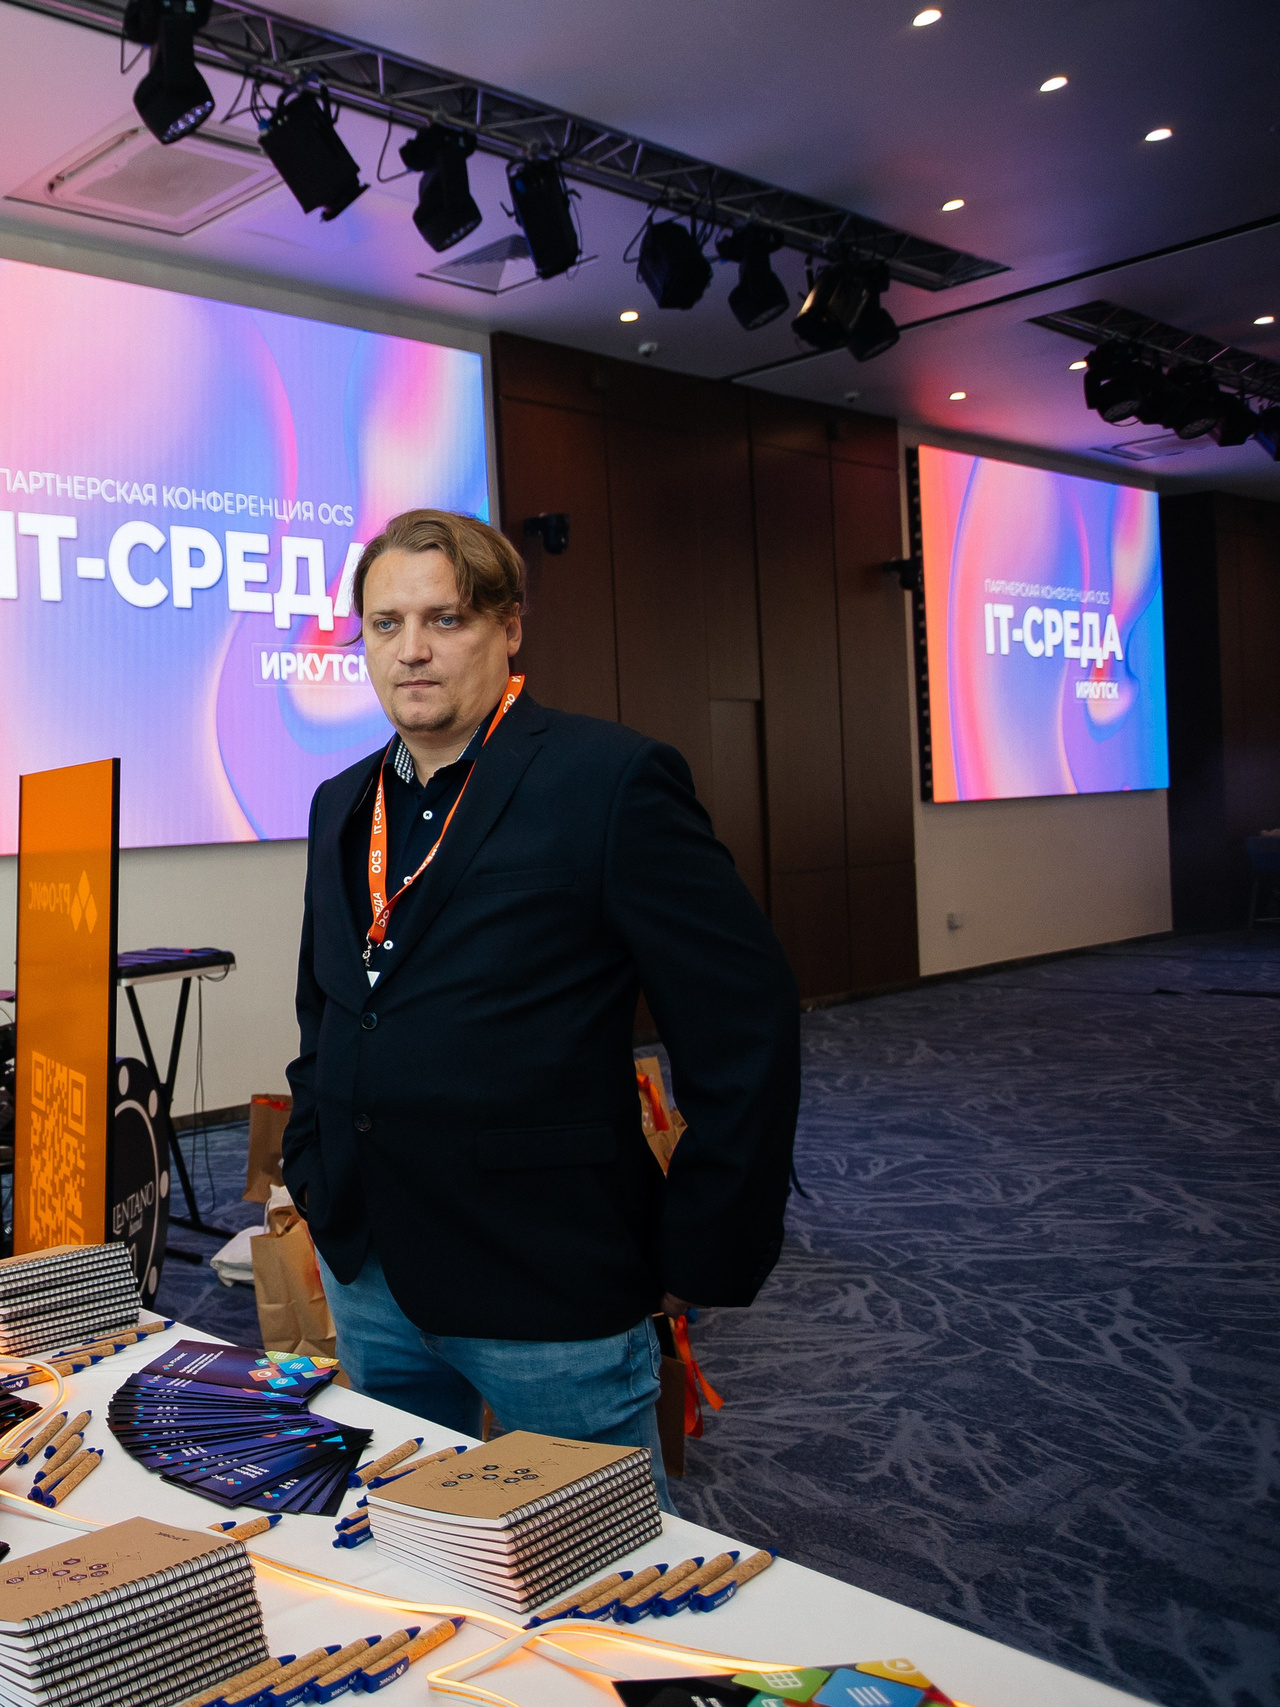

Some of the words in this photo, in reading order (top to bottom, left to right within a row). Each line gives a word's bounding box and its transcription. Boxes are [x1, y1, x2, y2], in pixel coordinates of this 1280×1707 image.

[162, 485, 315, 524] КОНФЕРЕНЦИЯ
[317, 503, 355, 527] OCS
[984, 603, 1124, 669] IT-СРЕДА
[1075, 680, 1119, 700] ИРКУТСК
[371, 850, 382, 874] OCS
